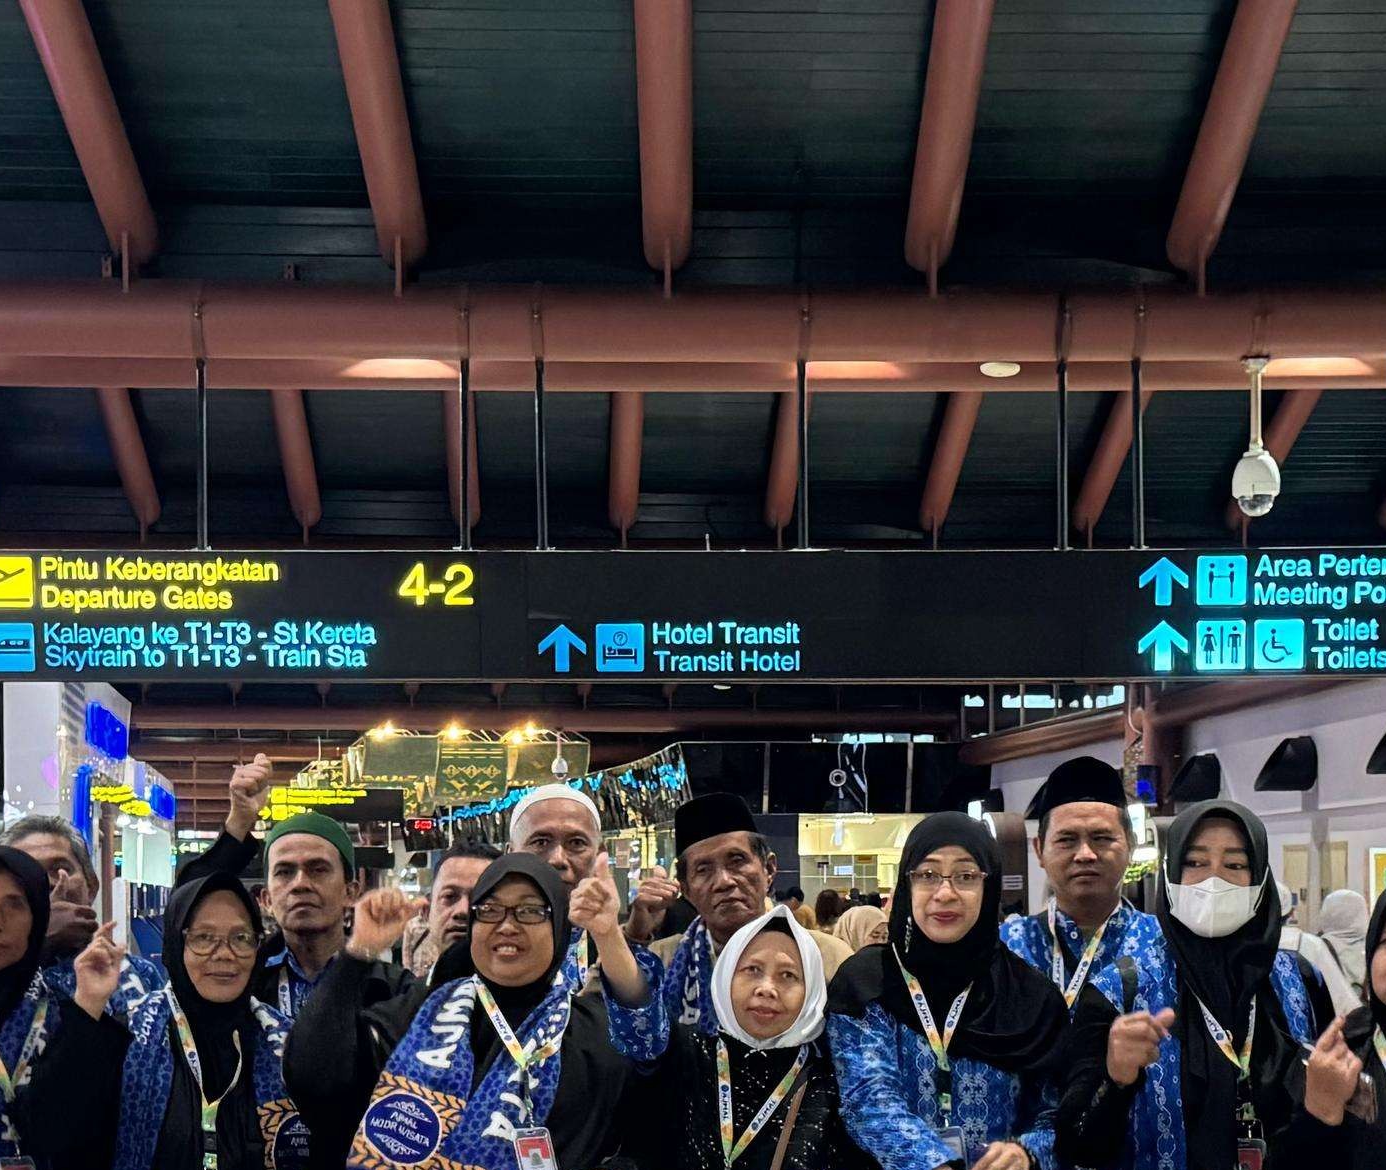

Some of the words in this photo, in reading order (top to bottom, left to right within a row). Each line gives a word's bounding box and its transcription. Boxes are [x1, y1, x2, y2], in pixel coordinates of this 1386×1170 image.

[40, 557, 98, 580] Pintu
[106, 557, 279, 586] Keberangkatan
[1255, 555, 1312, 577] Area
[398, 561, 473, 606] 4-2
[1254, 581, 1347, 609] Meeting
[41, 586, 155, 612] Departure
[163, 586, 233, 611] Gates
[44, 621, 145, 650] Kalayang
[152, 621, 179, 645] ke
[184, 620, 250, 645] T1-T3
[274, 621, 299, 645] St
[305, 621, 377, 646] Kereta
[653, 621, 712, 645] Hotel
[718, 621, 801, 645] Transit
[1312, 617, 1380, 642] Toilet
[45, 645, 137, 673] Skytrain
[142, 647, 165, 668] to
[170, 644, 240, 668] T1-T3
[261, 644, 321, 668] Train
[326, 645, 368, 668] Sta
[654, 651, 734, 673] Transit
[740, 650, 801, 672] Hotel
[415, 980, 476, 1068] AJMA
[722, 1092, 730, 1121] AJMAL
[757, 1099, 777, 1125] AJMAL
